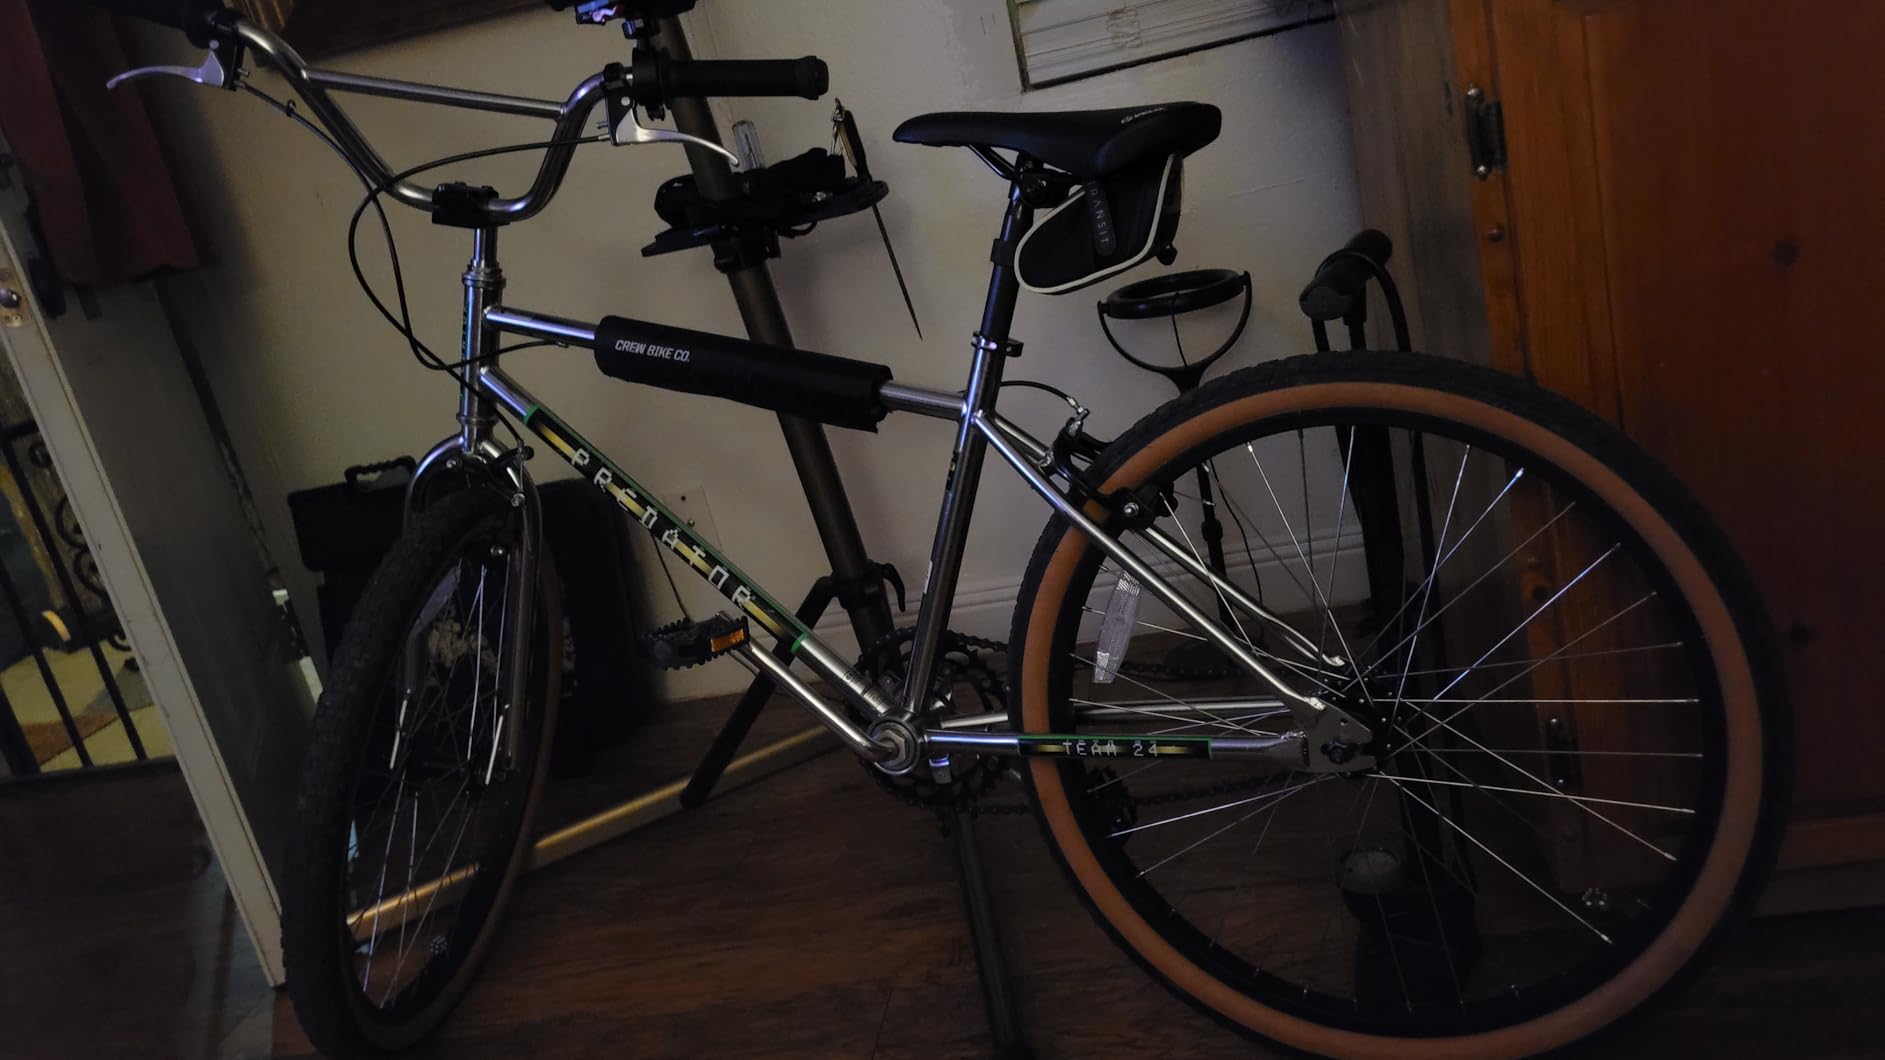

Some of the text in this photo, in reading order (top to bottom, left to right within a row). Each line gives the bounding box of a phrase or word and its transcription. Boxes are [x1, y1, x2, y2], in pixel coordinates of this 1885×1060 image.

[615, 339, 647, 355] CREW
[646, 344, 675, 360] BIKE
[571, 447, 756, 607] PREDATOR
[1062, 740, 1159, 757] TEAM 24
